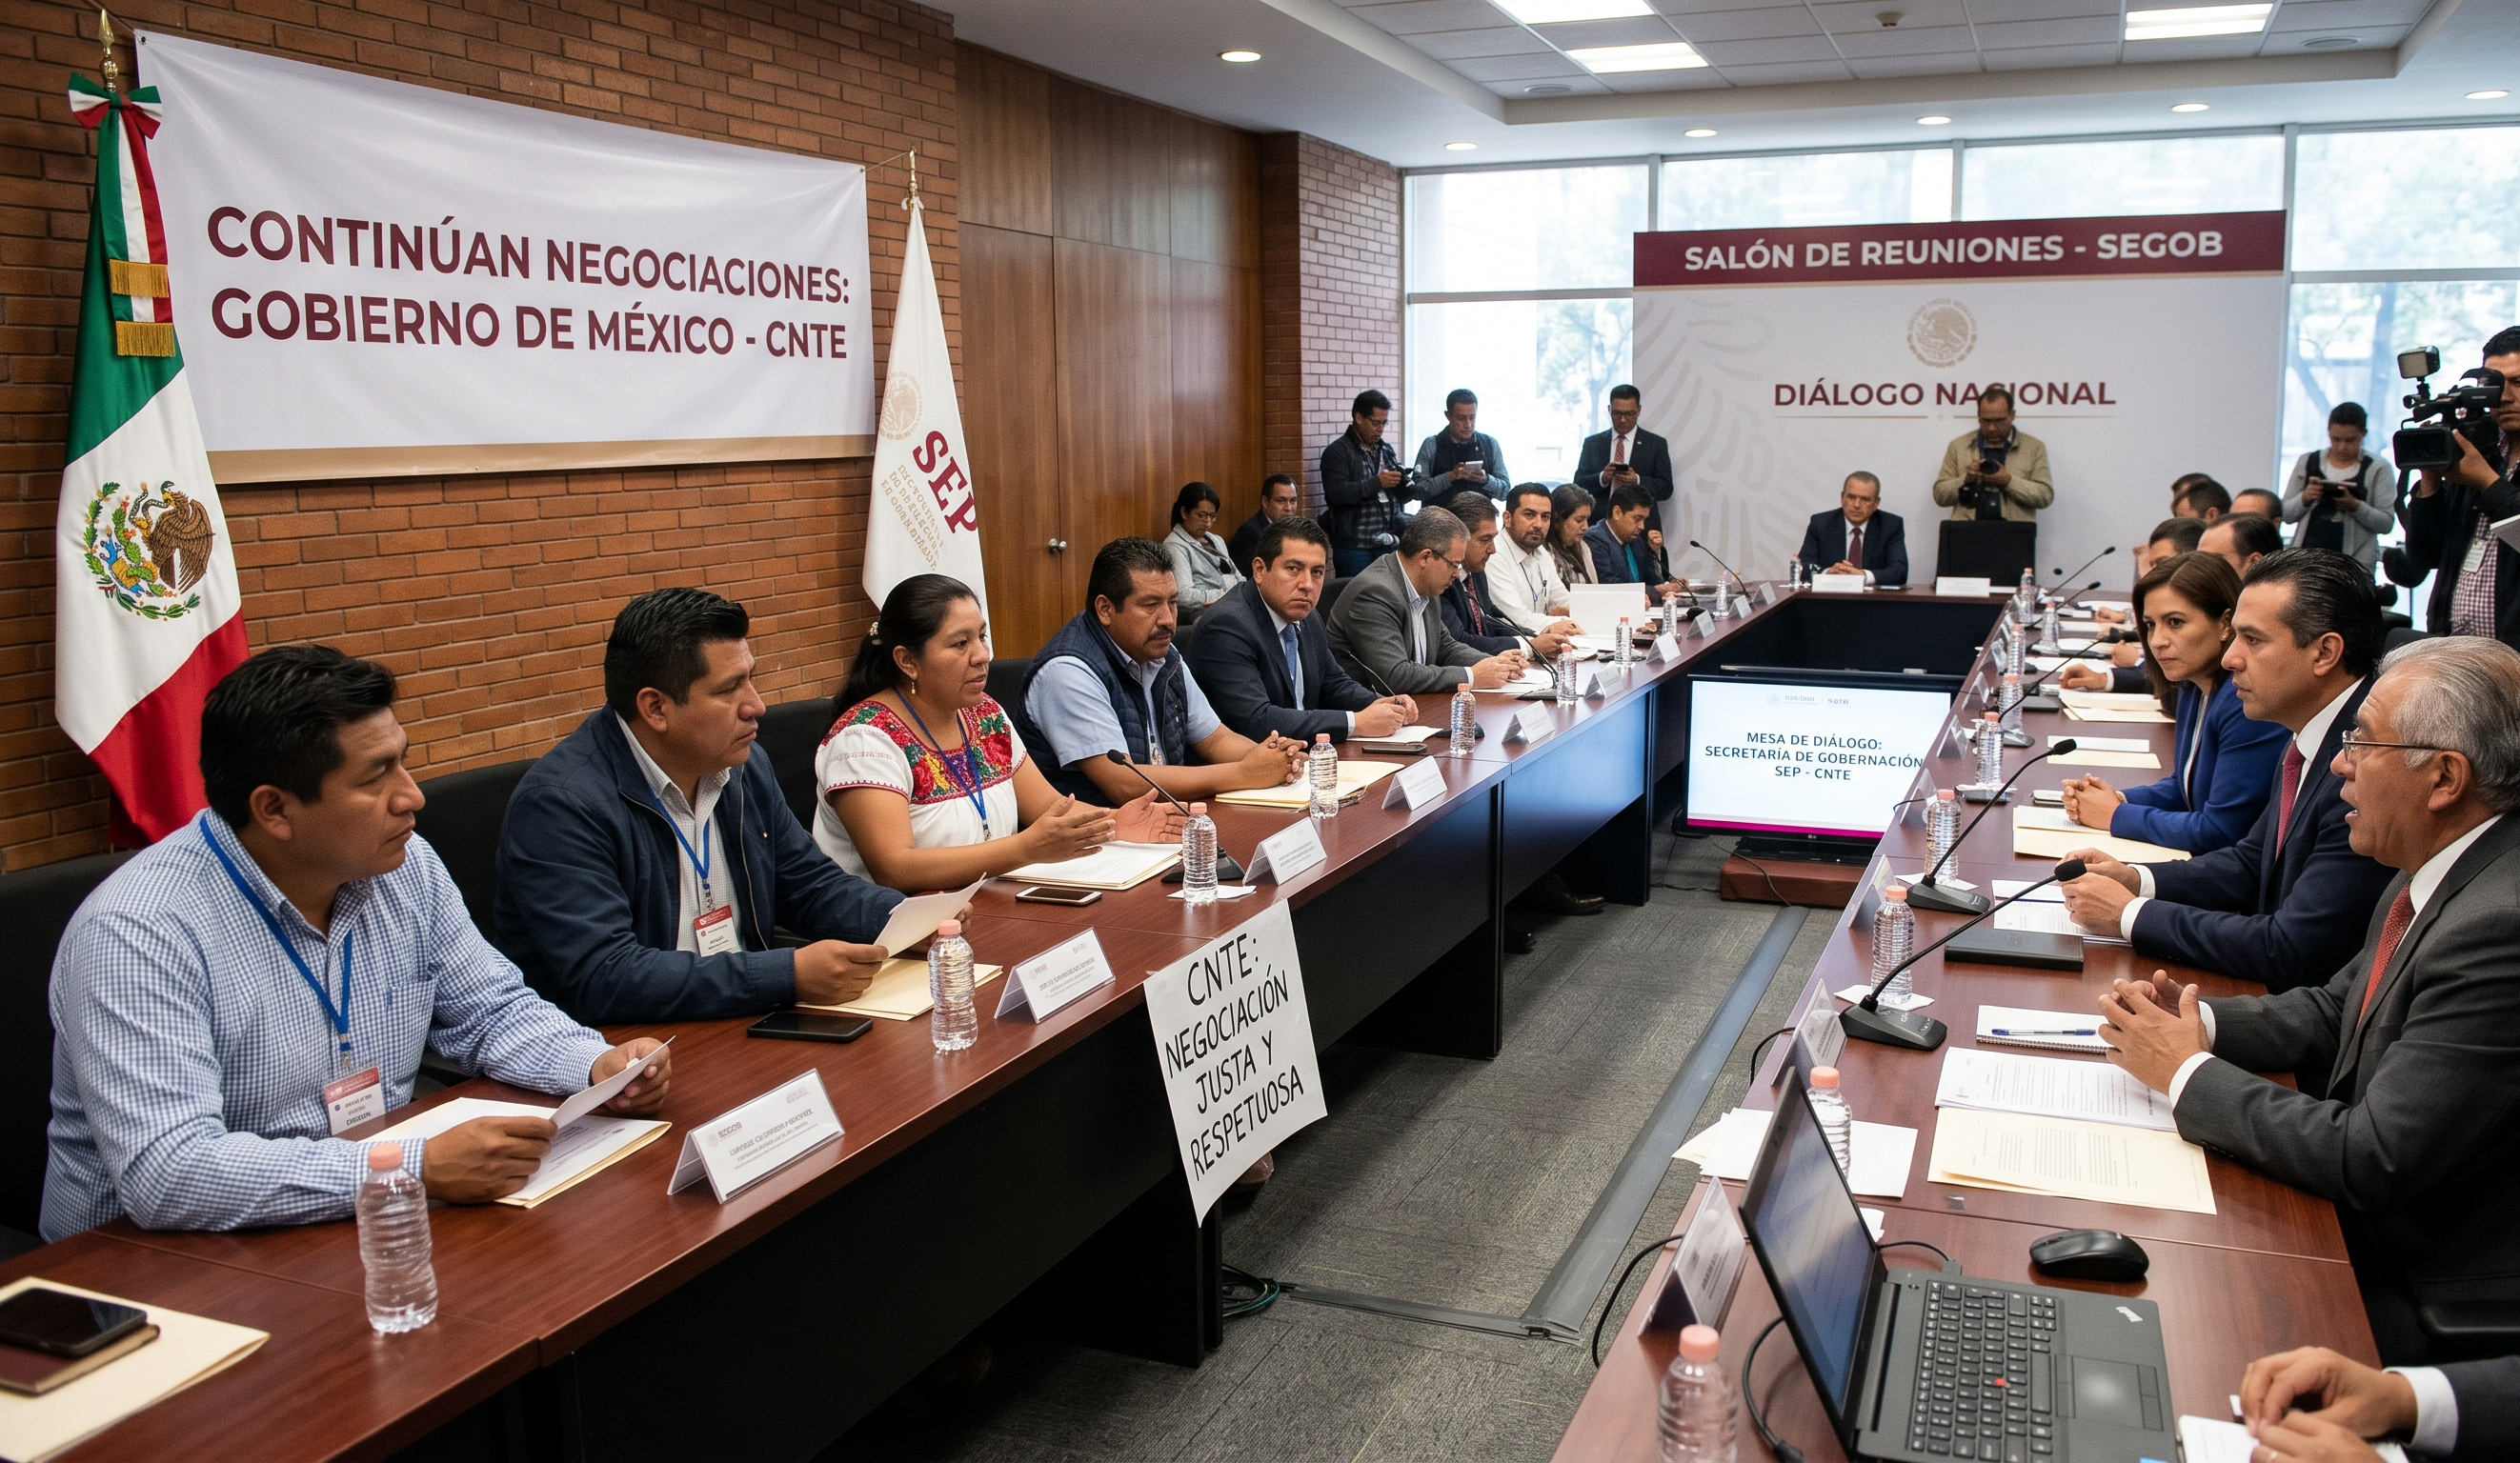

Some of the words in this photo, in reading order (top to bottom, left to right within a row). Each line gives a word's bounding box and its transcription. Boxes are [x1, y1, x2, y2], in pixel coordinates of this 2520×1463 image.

[206, 205, 531, 279] CONTINÚAN
[545, 238, 850, 305] NEGOCIACIONES:
[1683, 238, 1796, 271] SALÓN
[1804, 241, 1852, 268] DE
[1860, 234, 2066, 267] REUNIONES
[2095, 230, 2225, 260] SEGOB
[211, 286, 501, 348] GOBIERNO
[514, 305, 575, 351] DE
[587, 300, 735, 355] MÉXICO
[744, 335, 757, 346] -
[765, 320, 848, 359] CNTE
[1773, 377, 1925, 407] DIÁLOGO
[912, 430, 979, 534] SEP
[1704, 745, 1791, 762] SECRETARÍA
[1795, 751, 1814, 763] DE
[1817, 752, 1924, 769] GOBERNACIÓN
[1746, 732, 1786, 745] MESA
[1790, 734, 1809, 747] DE
[1813, 733, 1883, 751] DIÁLOGO:
[1775, 766, 1802, 778] SEP
[1814, 768, 1851, 781] CNTE
[1186, 932, 1260, 1006] CNTE:
[1164, 963, 1289, 1080] NEGOCIACIÓN
[1194, 1044, 1258, 1114] JUSTA
[1260, 1030, 1273, 1067] Y
[1190, 1064, 1305, 1182] RESPETUOSA
